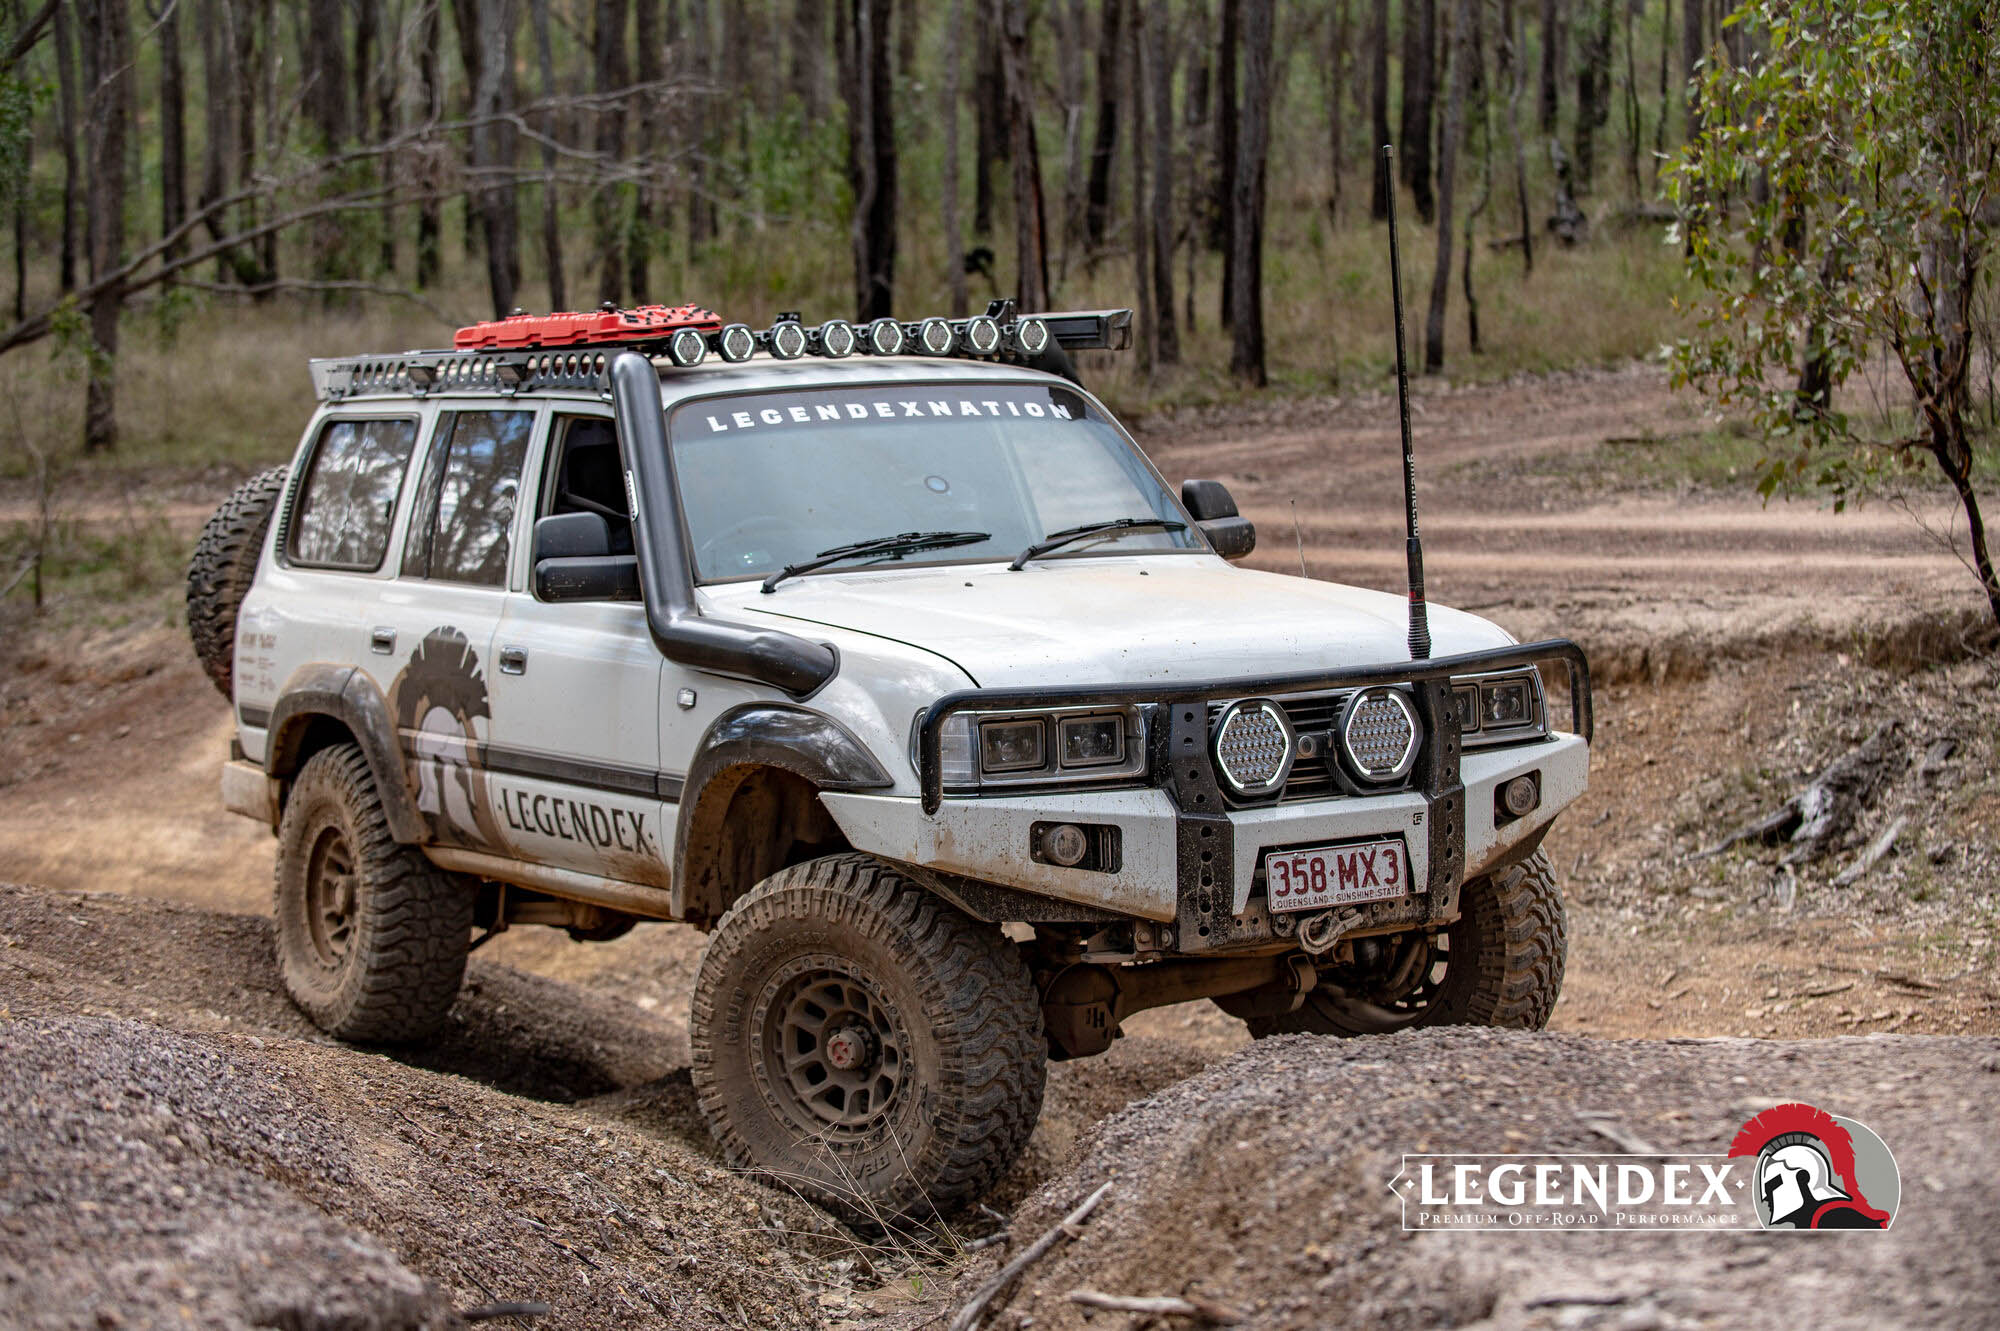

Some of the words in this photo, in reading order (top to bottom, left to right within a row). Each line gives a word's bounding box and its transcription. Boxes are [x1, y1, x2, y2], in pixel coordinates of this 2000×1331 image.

[707, 400, 1072, 432] LEGENDEXNATION
[502, 788, 653, 856] LEGENDEX
[1276, 895, 1329, 908] QUEENSLAND
[1336, 891, 1374, 902] SUNSHINE
[1378, 887, 1400, 897] STATE
